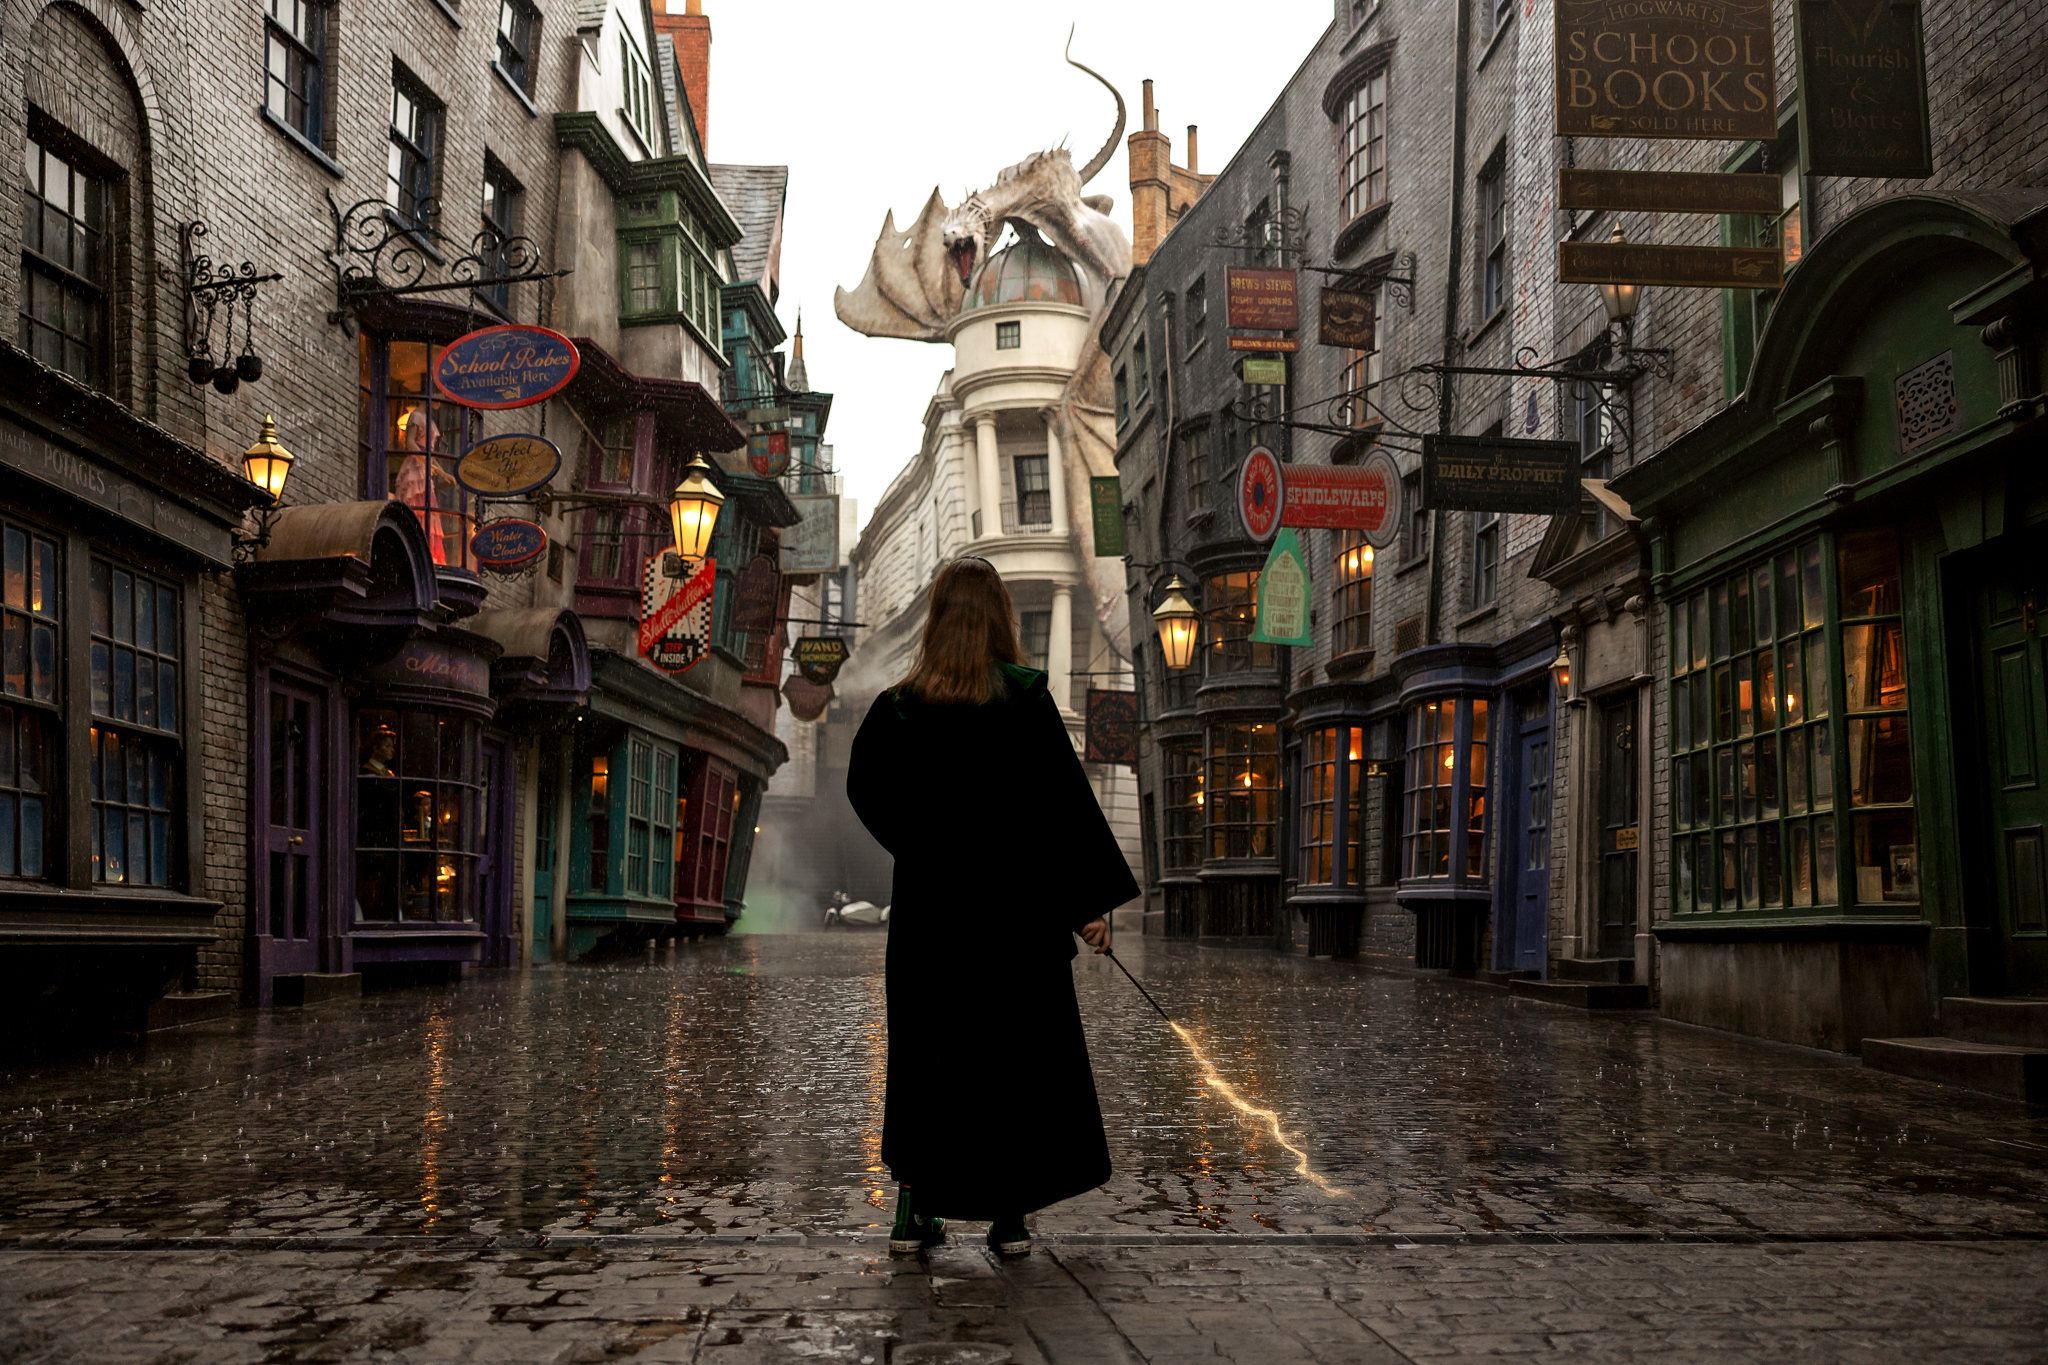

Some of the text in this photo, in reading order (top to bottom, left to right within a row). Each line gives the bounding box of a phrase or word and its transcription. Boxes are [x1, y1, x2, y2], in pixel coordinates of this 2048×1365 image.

[1609, 1, 1719, 23] HOGWARTS
[1569, 31, 1765, 66] SCHOOL
[1815, 46, 1909, 69] Flourish
[1568, 68, 1768, 112] BOOKS
[1628, 117, 1736, 132] SOLD HERE
[1230, 277, 1293, 292] BREWS STEWS
[441, 347, 570, 376] School Robes
[461, 370, 550, 390] Available Here
[483, 441, 532, 462] Perfect
[44, 443, 105, 495] POTAGES
[498, 457, 518, 473] Fit
[1438, 464, 1566, 484] DAILY PROPHET
[1287, 487, 1385, 507] SPINDLEWARPS
[491, 529, 524, 543] Winter
[491, 543, 528, 557] Cloaks
[664, 642, 683, 653] STEP
[800, 652, 842, 662] SHOWROOM
[801, 641, 842, 653] WAND
[660, 652, 685, 664] INSIDE
